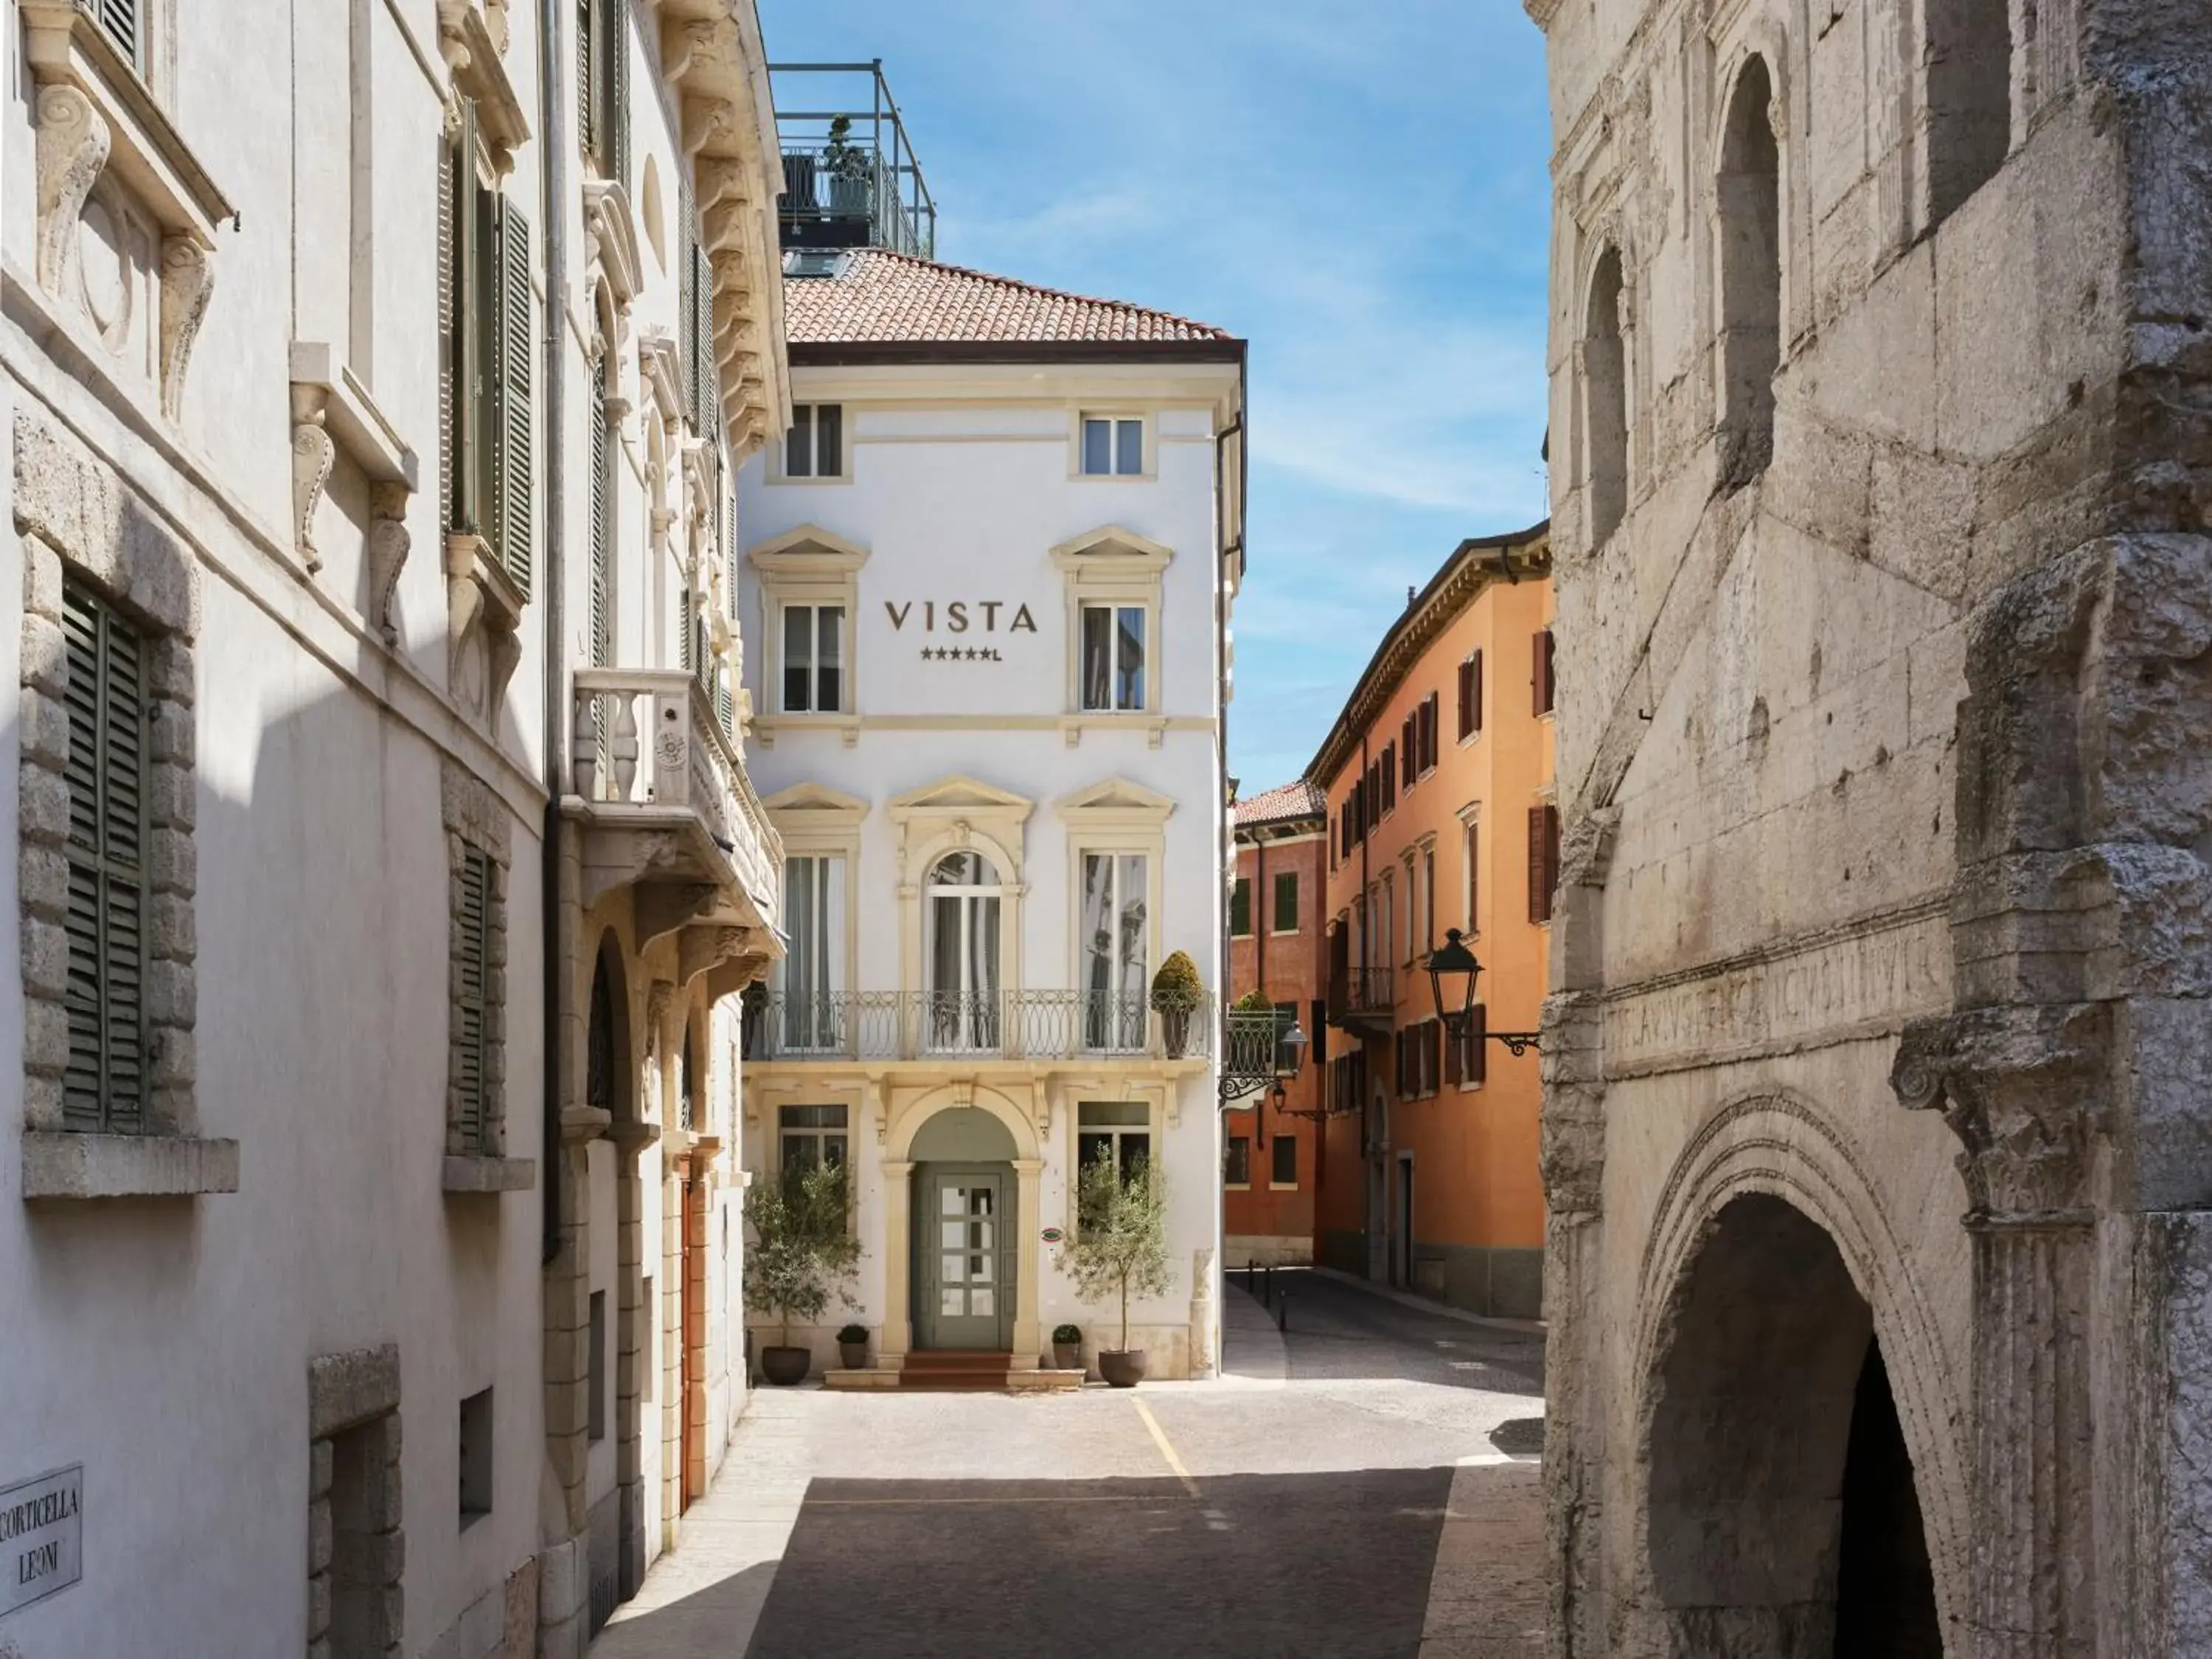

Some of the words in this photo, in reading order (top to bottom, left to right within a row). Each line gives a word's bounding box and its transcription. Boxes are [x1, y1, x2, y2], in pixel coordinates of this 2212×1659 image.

[884, 601, 1037, 633] VISTA
[0, 1487, 78, 1542] CORTICELLA
[18, 1540, 58, 1585] LEONI
